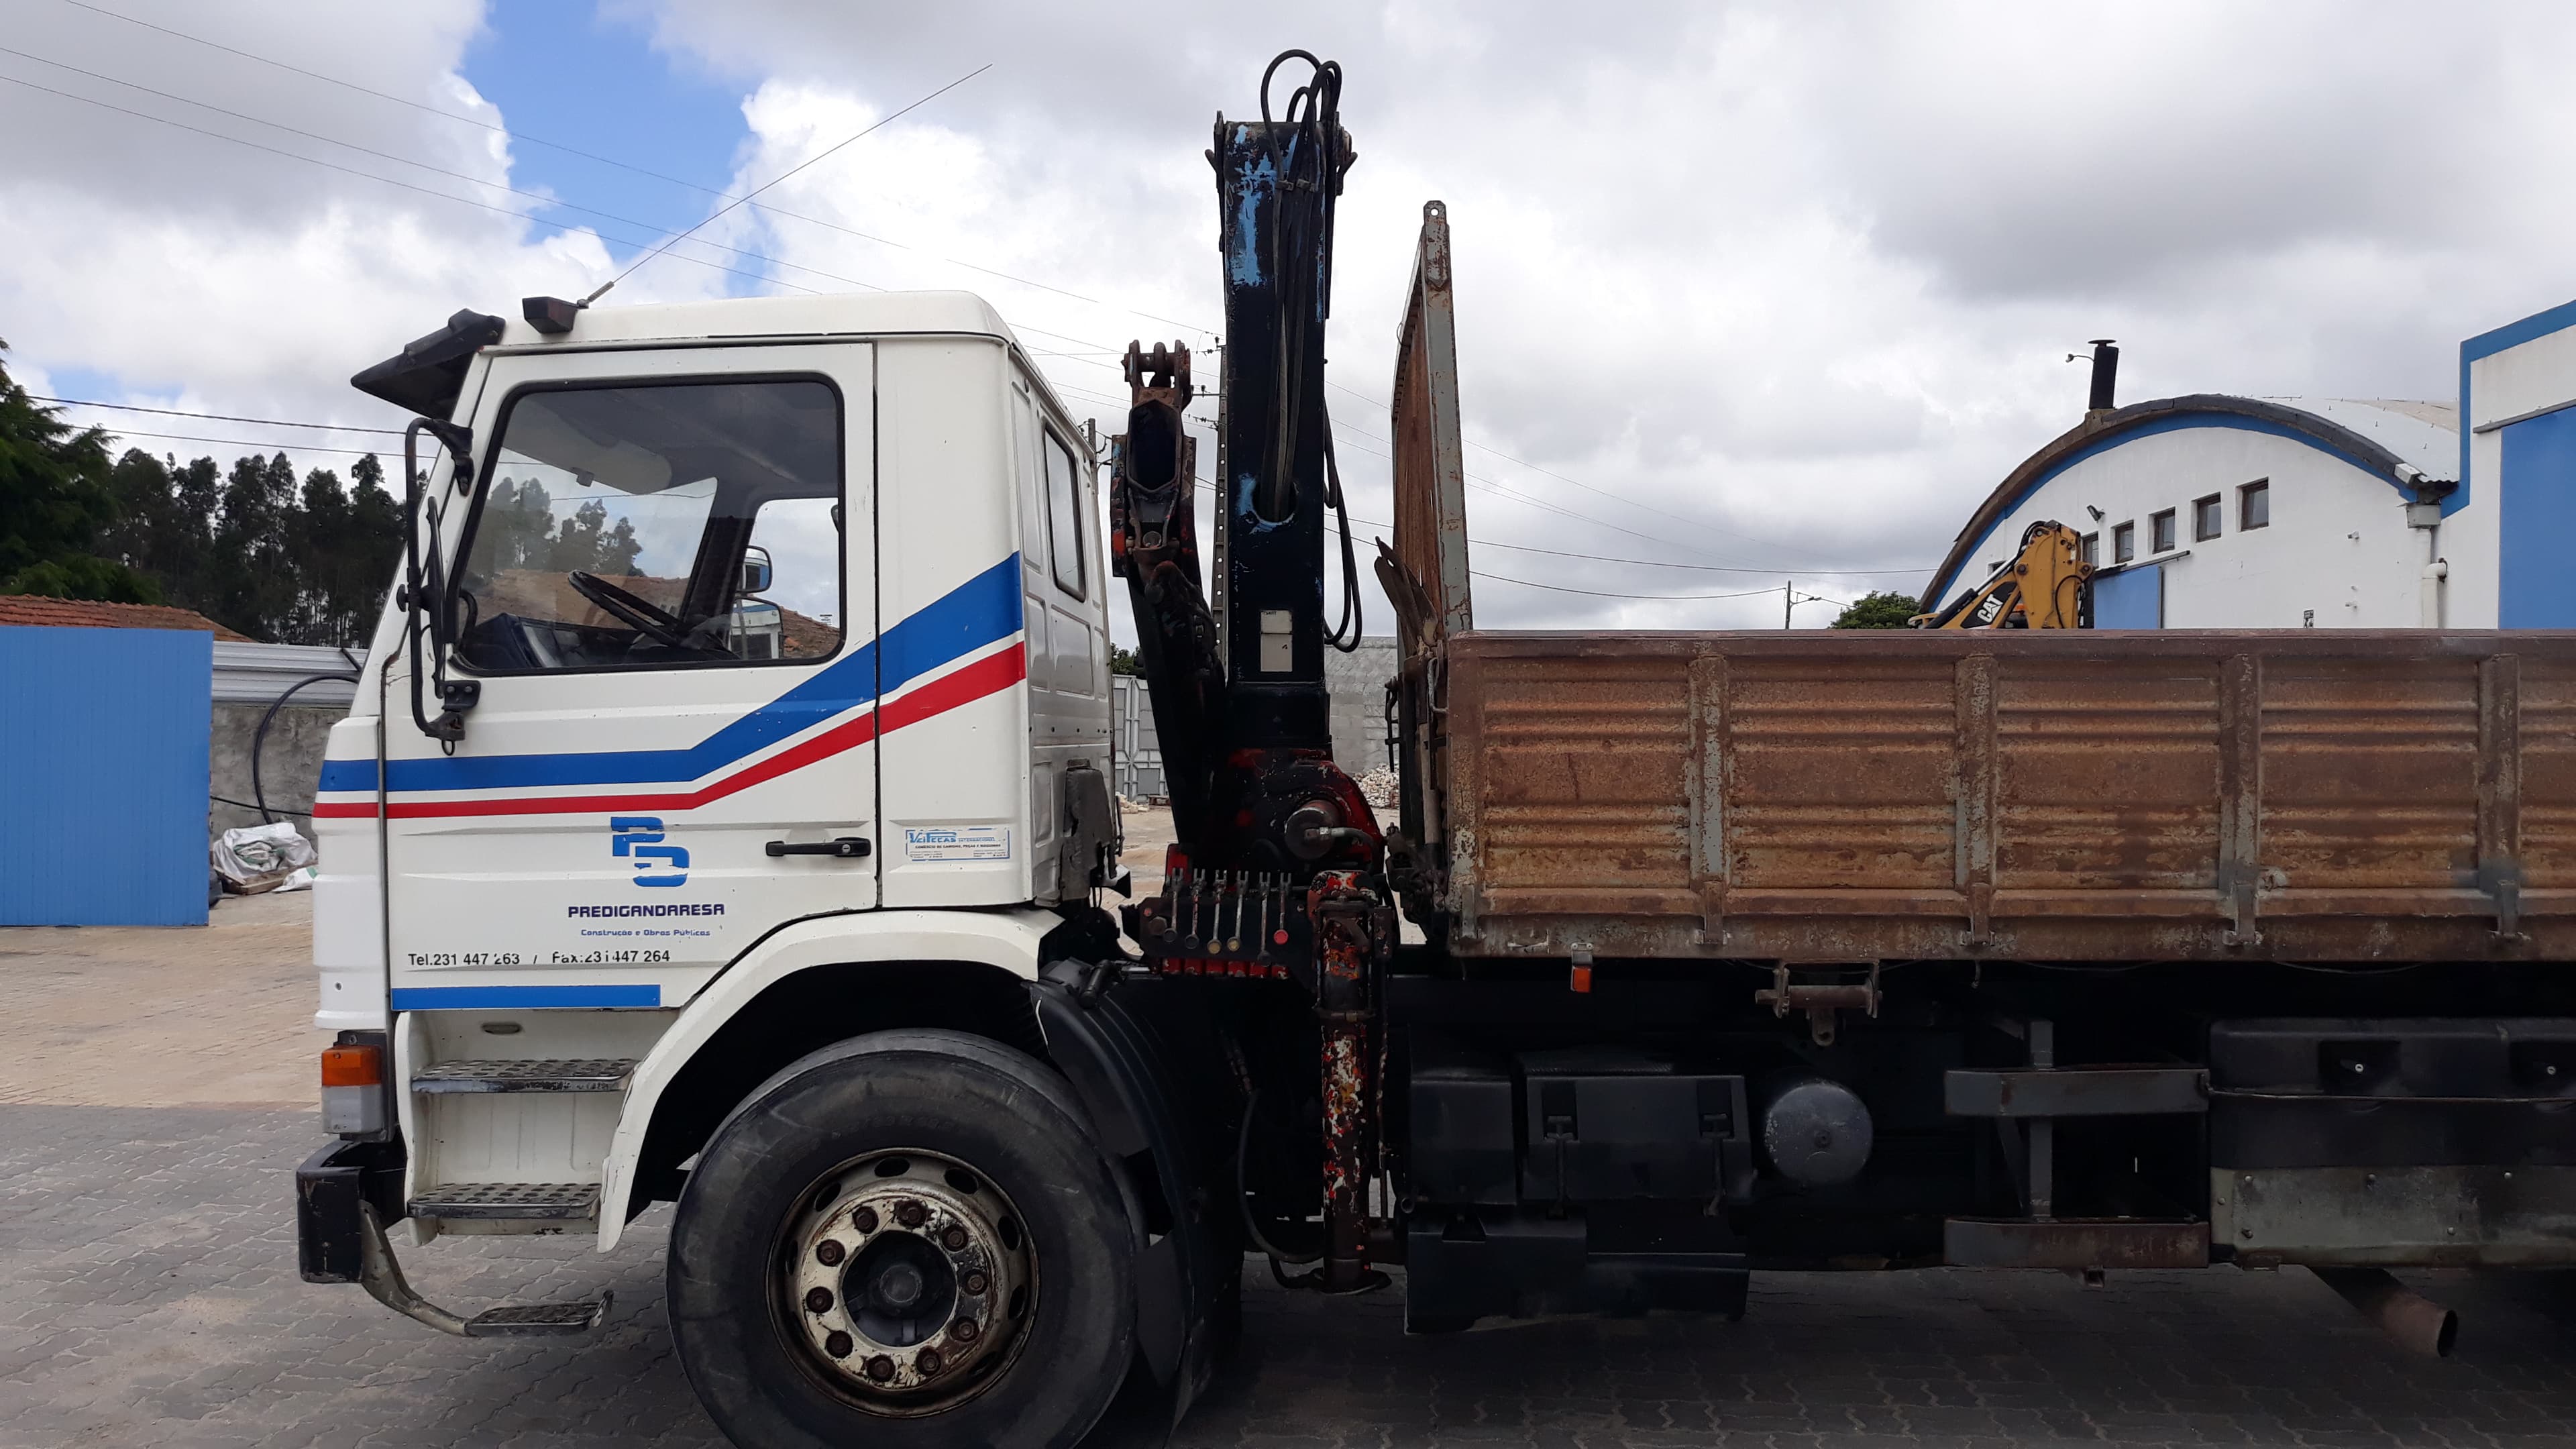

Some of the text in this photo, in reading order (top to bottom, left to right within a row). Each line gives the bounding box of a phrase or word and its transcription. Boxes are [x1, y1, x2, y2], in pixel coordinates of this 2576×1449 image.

[1977, 593, 2004, 623] CAT
[568, 904, 725, 918] PREDIGANDARESA
[408, 953, 457, 966] Tel.231
[463, 953, 489, 965] 447
[494, 953, 520, 965] 263
[643, 949, 671, 962] 264
